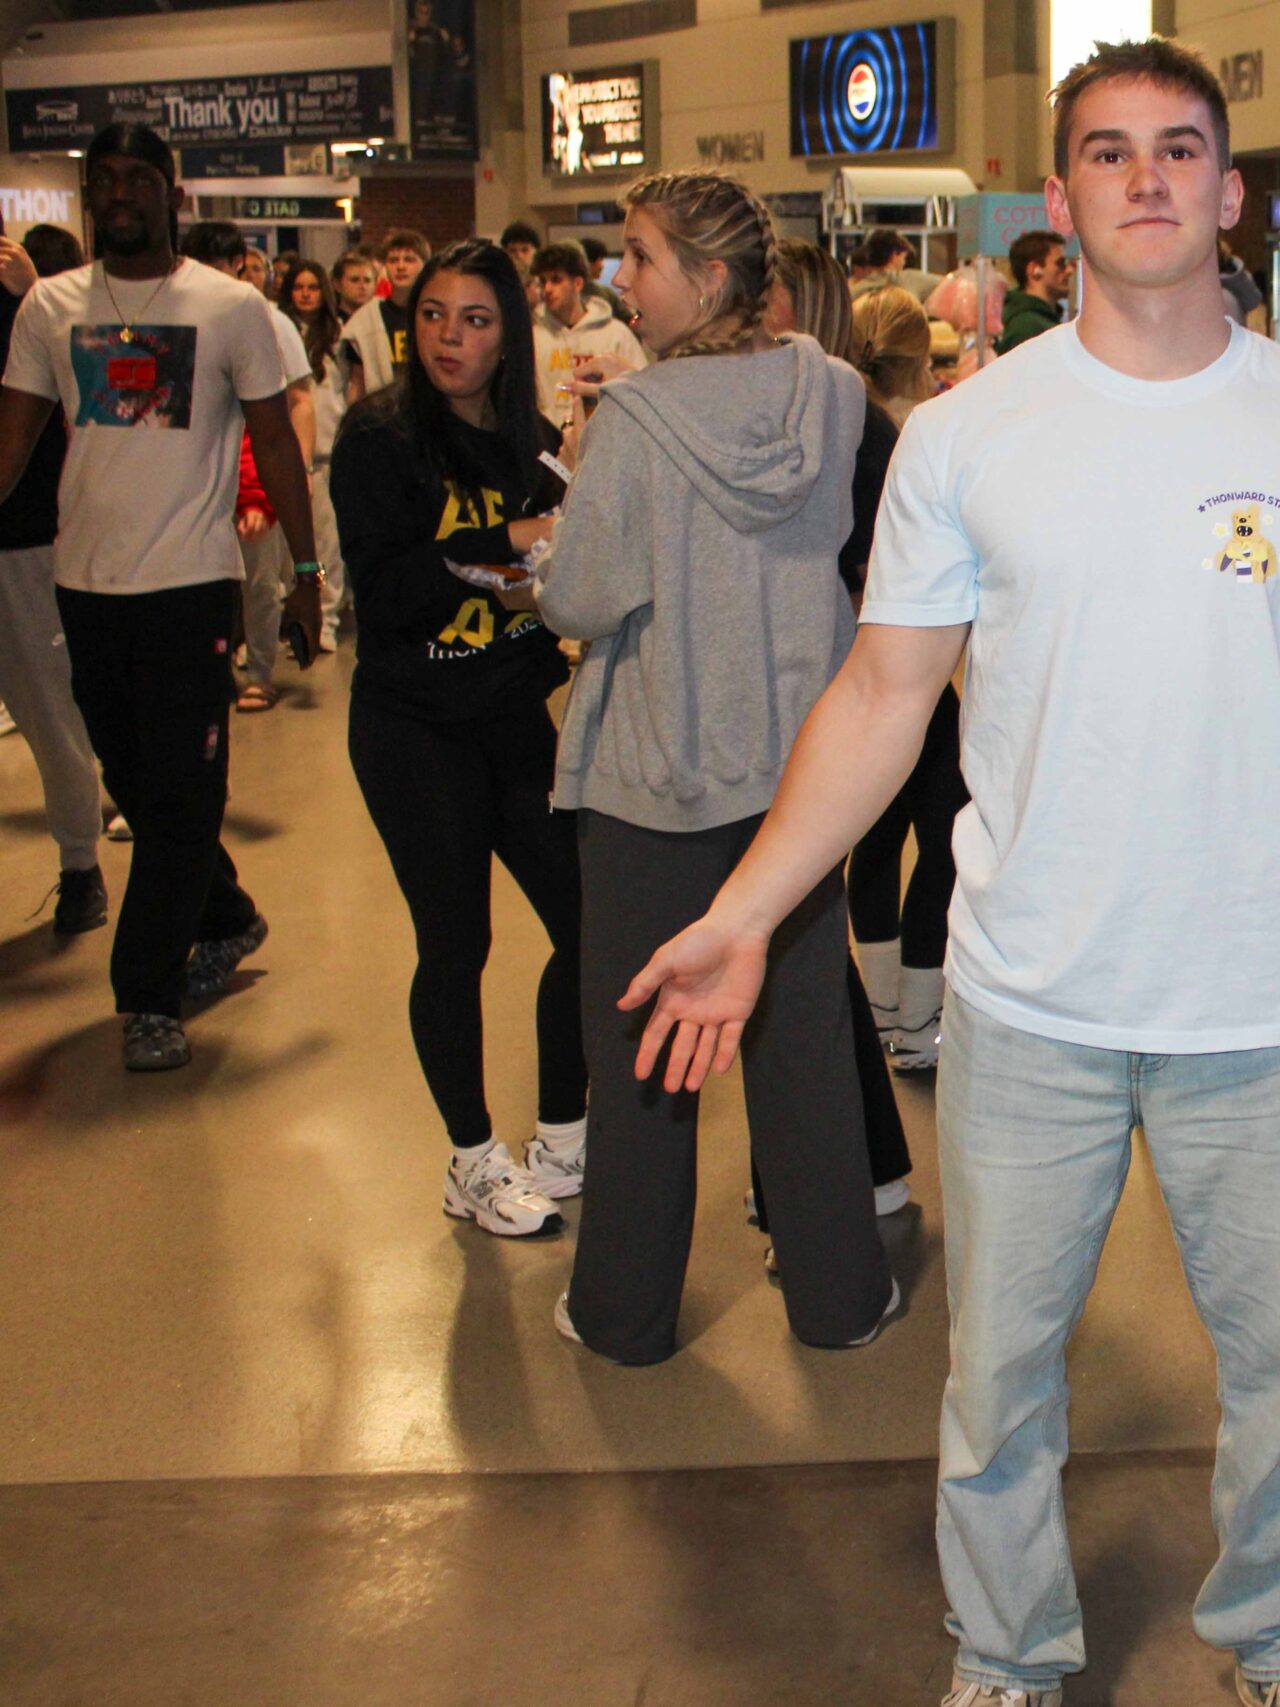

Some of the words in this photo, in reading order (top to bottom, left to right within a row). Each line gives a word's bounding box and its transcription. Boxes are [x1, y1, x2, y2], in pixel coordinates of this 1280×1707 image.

[164, 94, 231, 129] Thank
[237, 96, 278, 133] you
[696, 131, 764, 164] WOMEN
[1205, 491, 1266, 508] THONWARD
